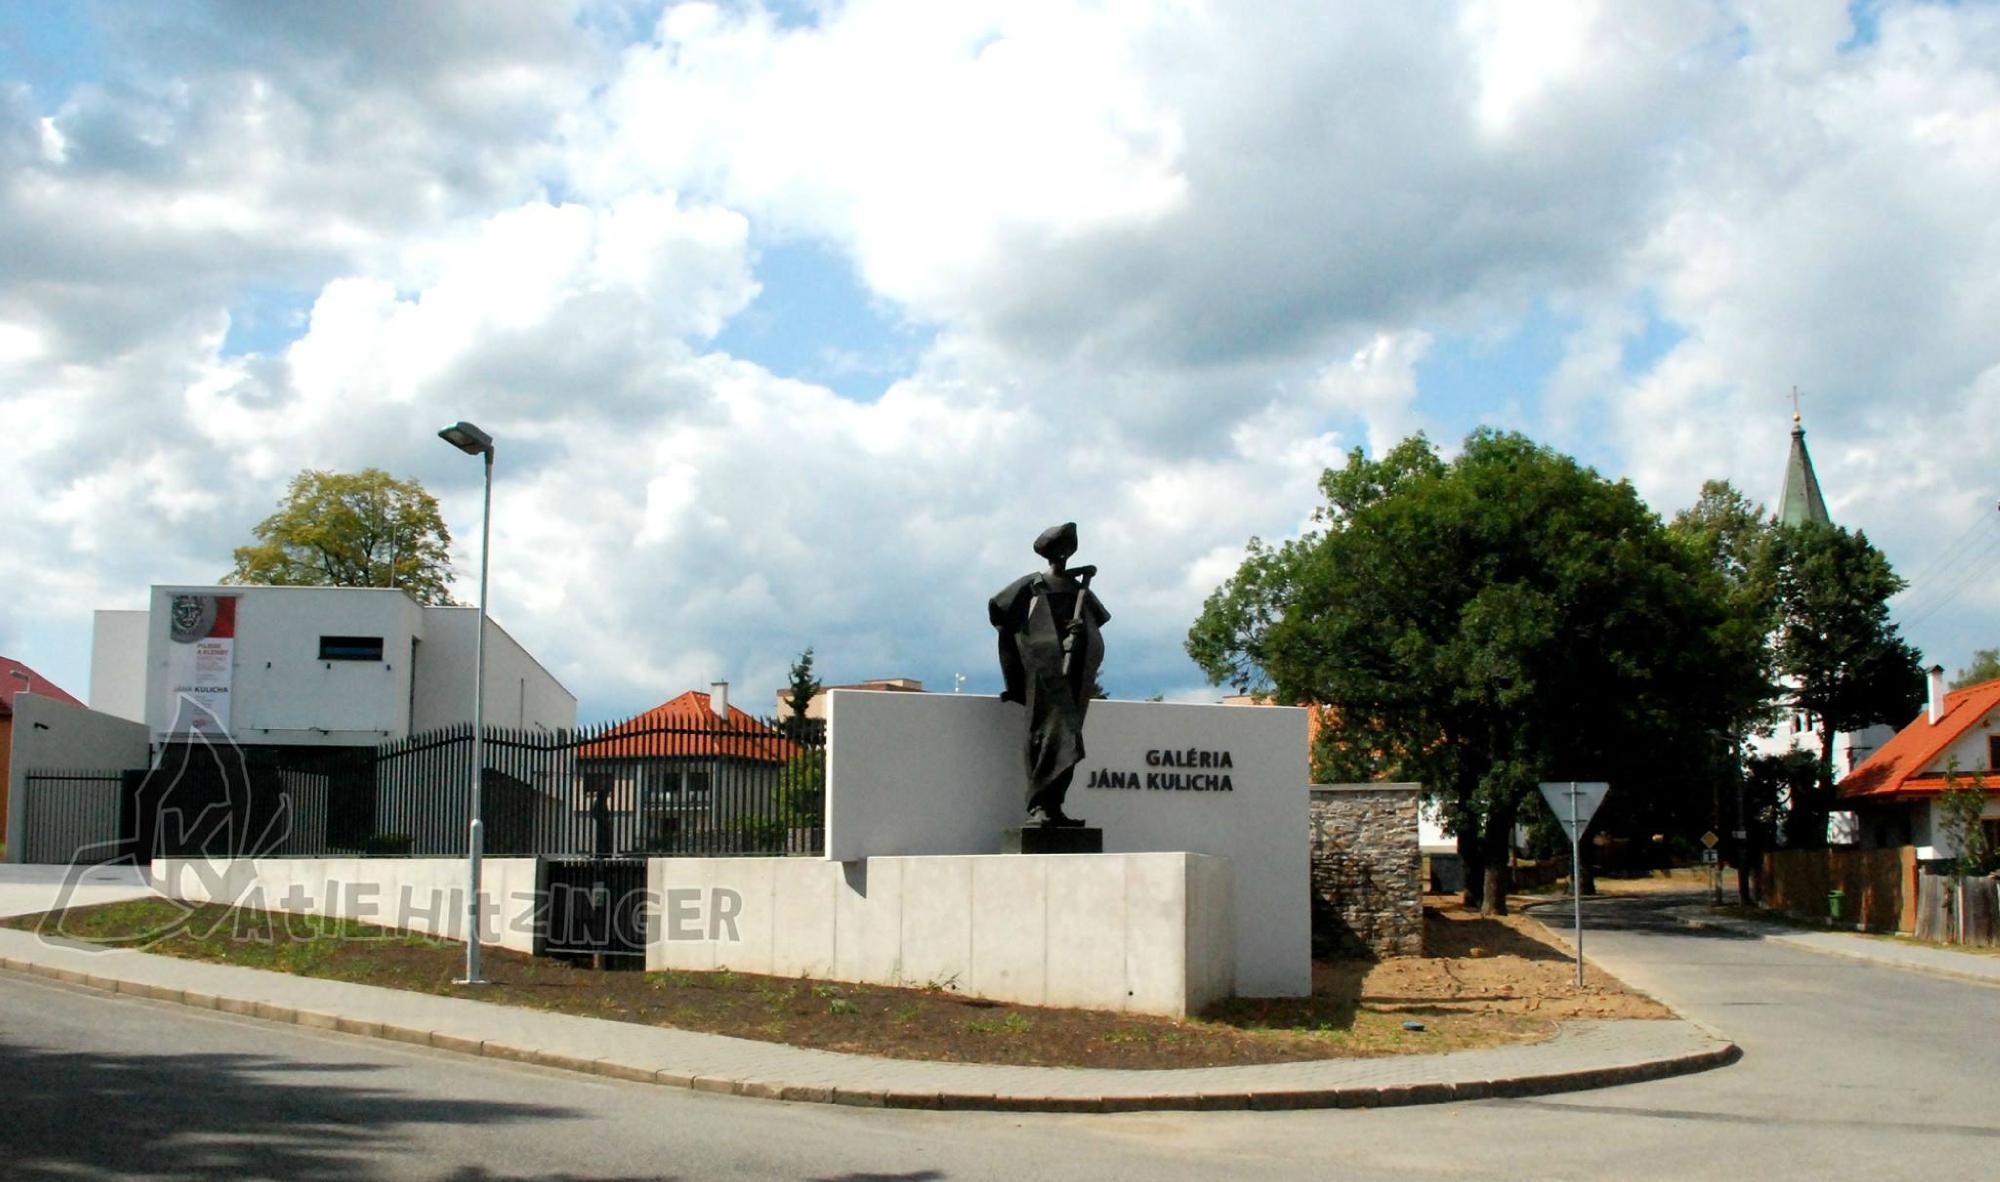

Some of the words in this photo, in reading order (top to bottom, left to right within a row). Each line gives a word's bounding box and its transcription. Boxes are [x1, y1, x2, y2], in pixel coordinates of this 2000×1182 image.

[1146, 748, 1233, 769] GALÉRIA
[1087, 768, 1141, 790] JÁNA
[1147, 772, 1233, 792] KULICHA
